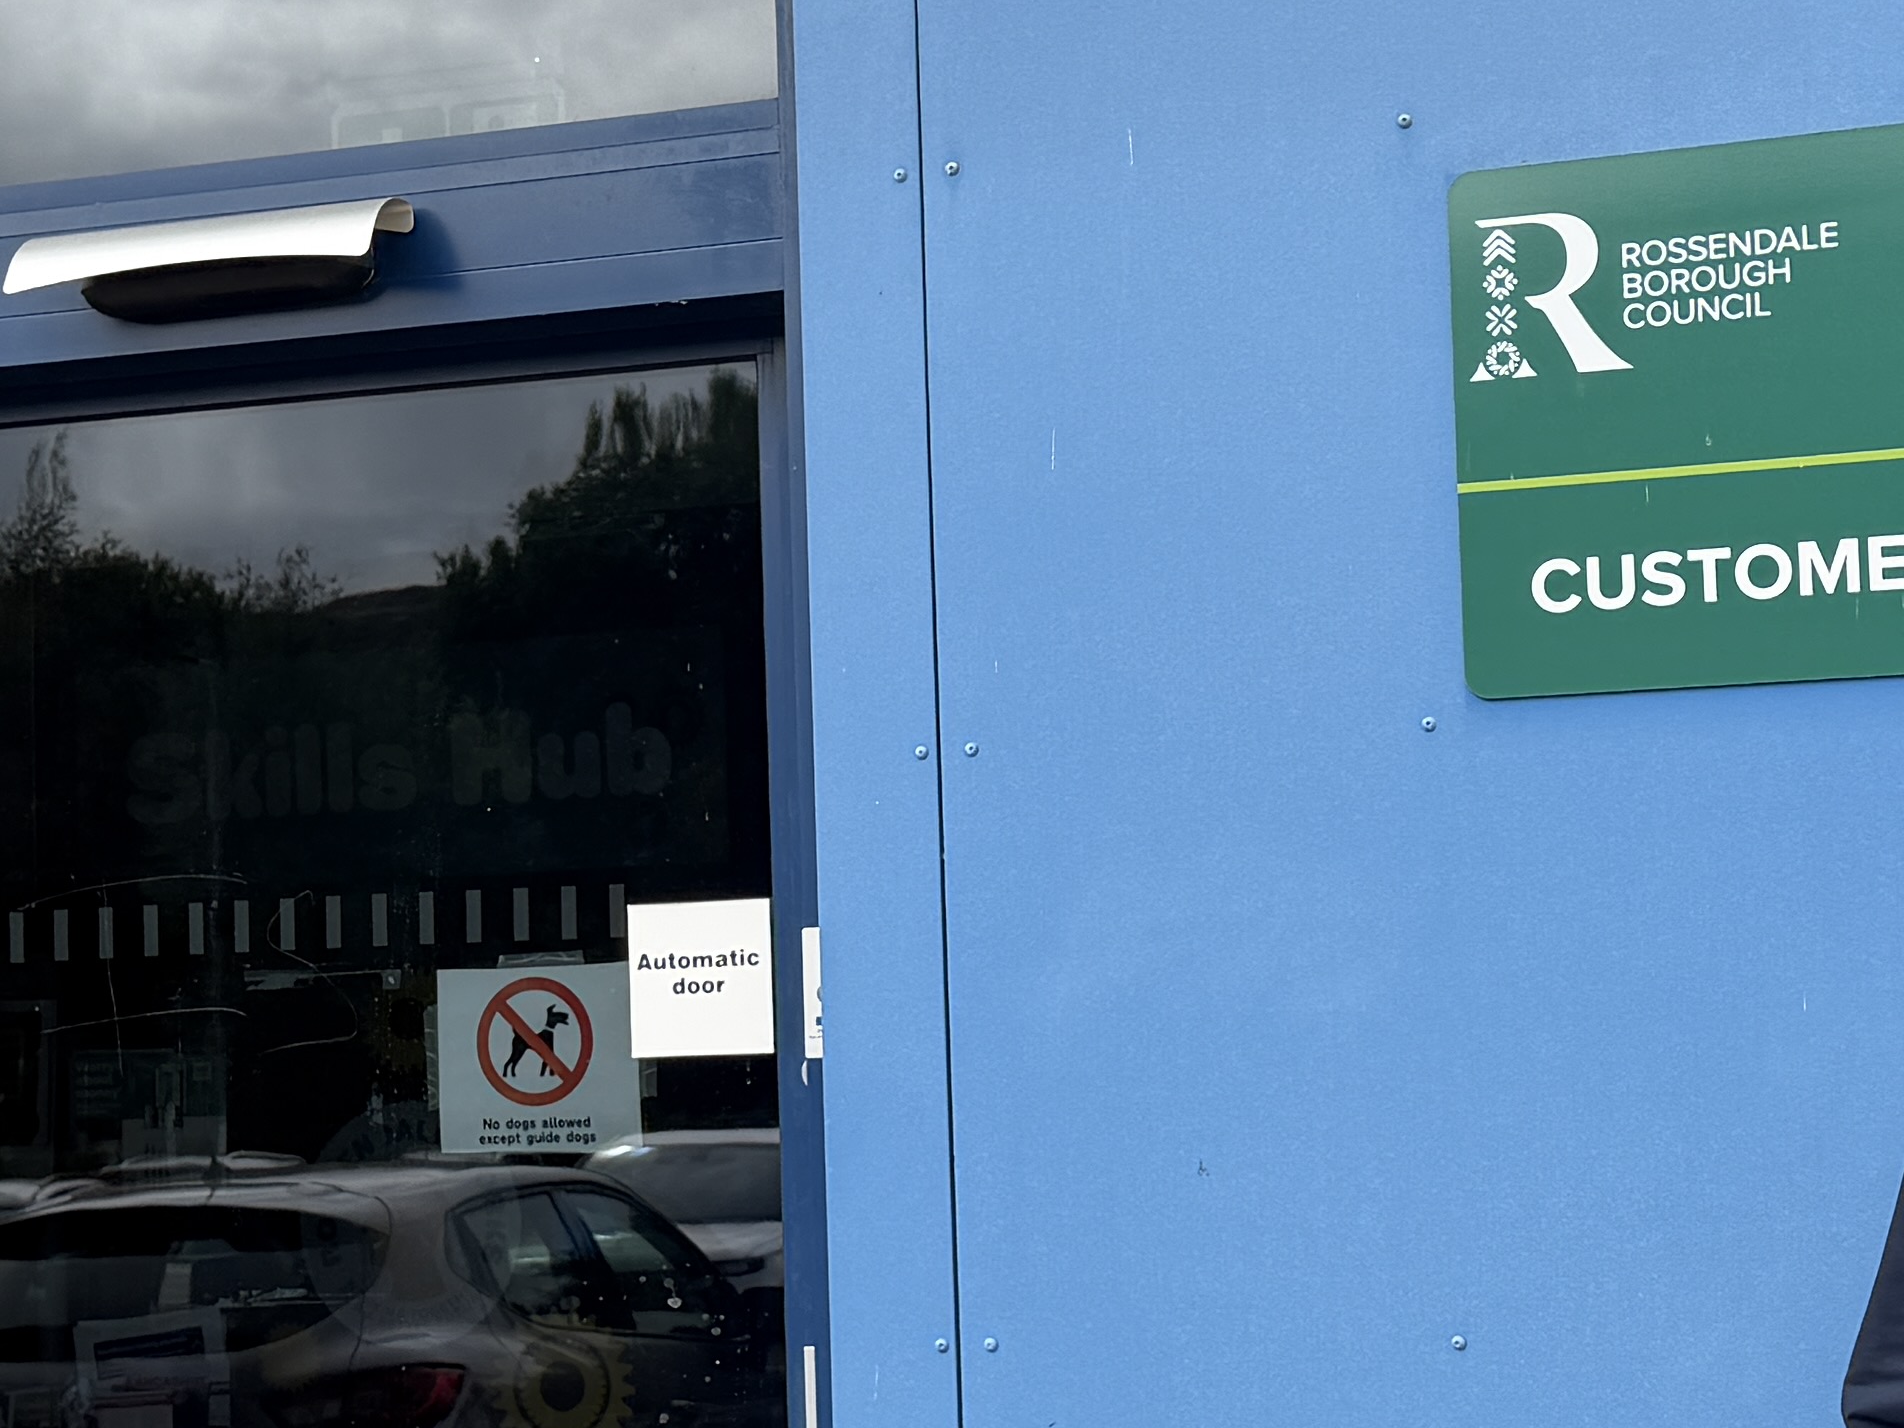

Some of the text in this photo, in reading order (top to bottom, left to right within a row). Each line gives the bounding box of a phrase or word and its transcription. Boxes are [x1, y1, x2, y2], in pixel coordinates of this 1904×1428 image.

[1619, 220, 1840, 269] ROSSENDALE
[1620, 257, 1792, 300] BOROUGH
[1621, 291, 1772, 330] COUNCIL
[637, 949, 760, 972] Automatic
[672, 976, 725, 995] door
[482, 1116, 591, 1132] No dogs allowed
[479, 1130, 596, 1147] except guide dogs
